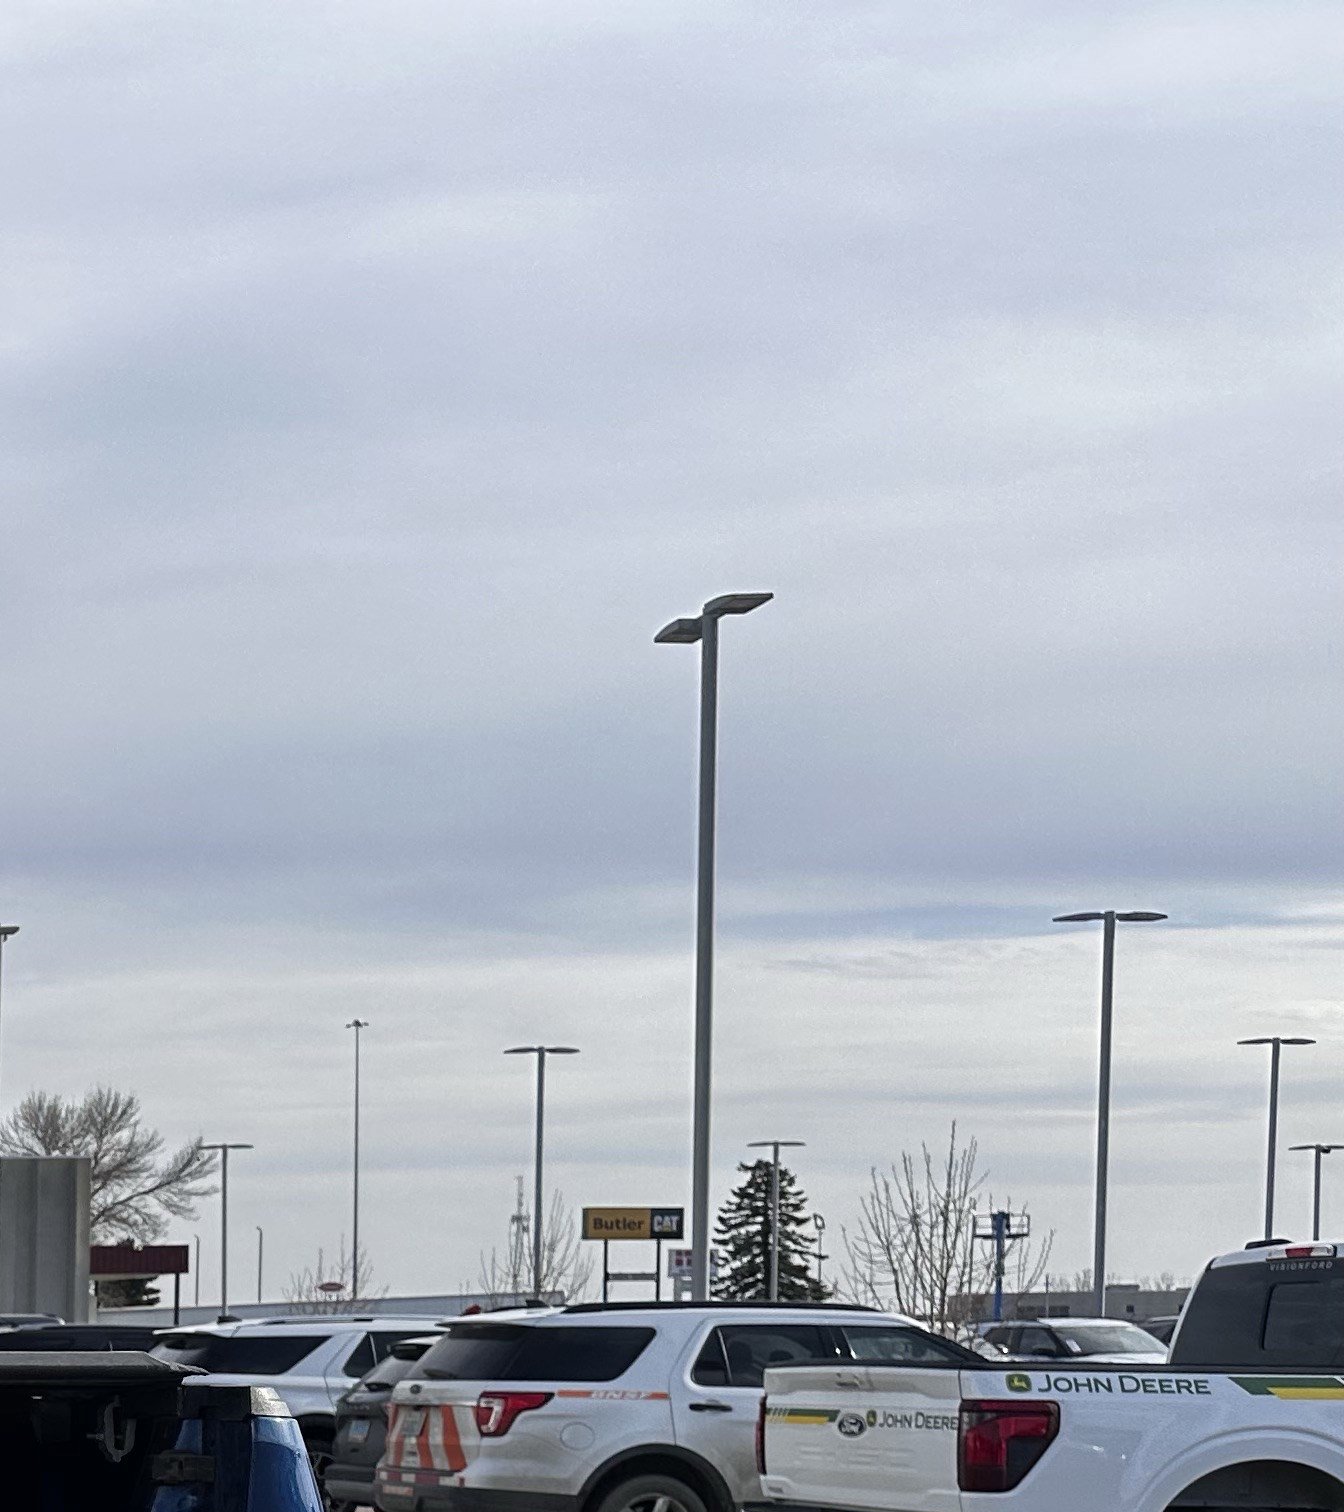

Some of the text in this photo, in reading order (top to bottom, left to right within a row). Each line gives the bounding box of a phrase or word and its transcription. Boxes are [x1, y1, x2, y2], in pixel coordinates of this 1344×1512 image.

[593, 1215, 679, 1232] Butler CAT
[1038, 1374, 1212, 1395] JOHN DEERE
[879, 1411, 958, 1431] JOHN DEERE
